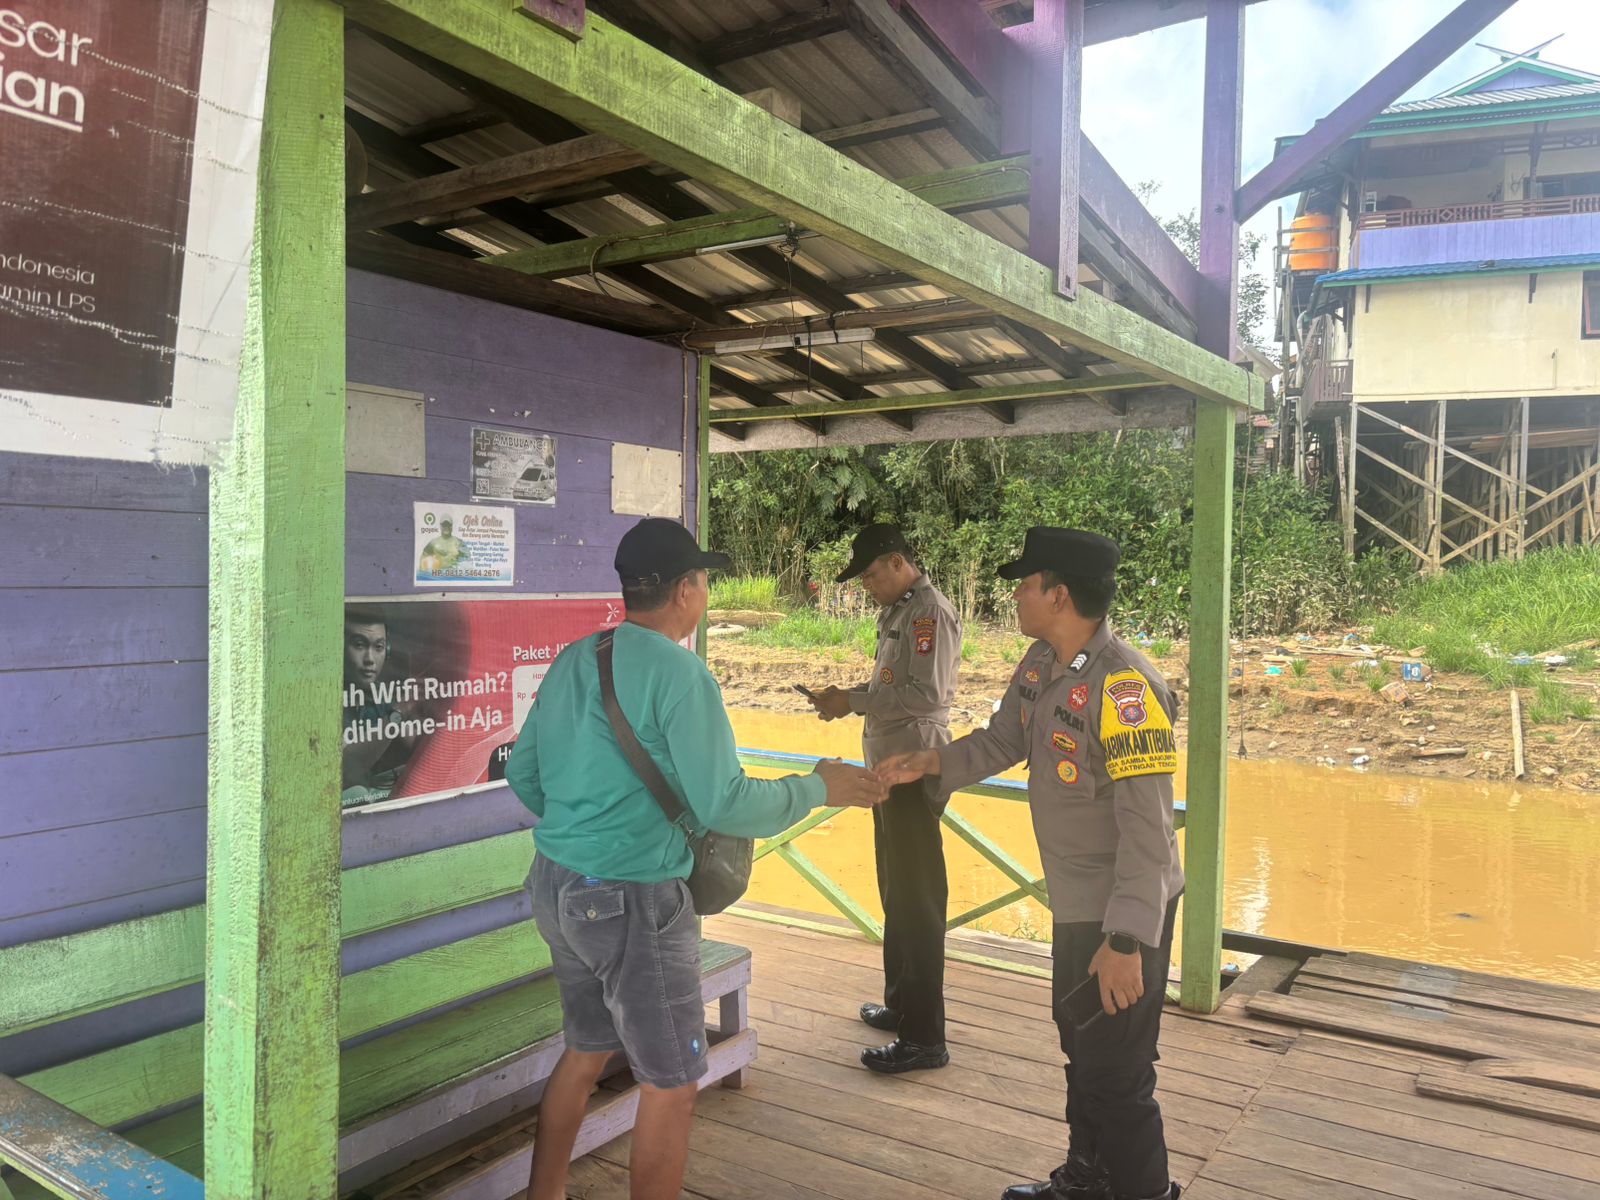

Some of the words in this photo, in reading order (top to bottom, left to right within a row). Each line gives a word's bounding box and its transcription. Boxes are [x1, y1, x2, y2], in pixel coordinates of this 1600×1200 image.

[57, 289, 96, 313] LPS
[463, 514, 479, 530] Ojek
[481, 515, 503, 527] Online
[513, 644, 551, 661] Paket
[370, 678, 419, 705] Wifi
[424, 671, 507, 700] Rumah?
[517, 691, 527, 701] Rp
[470, 705, 503, 732] Aja
[1054, 704, 1085, 733] POLRI
